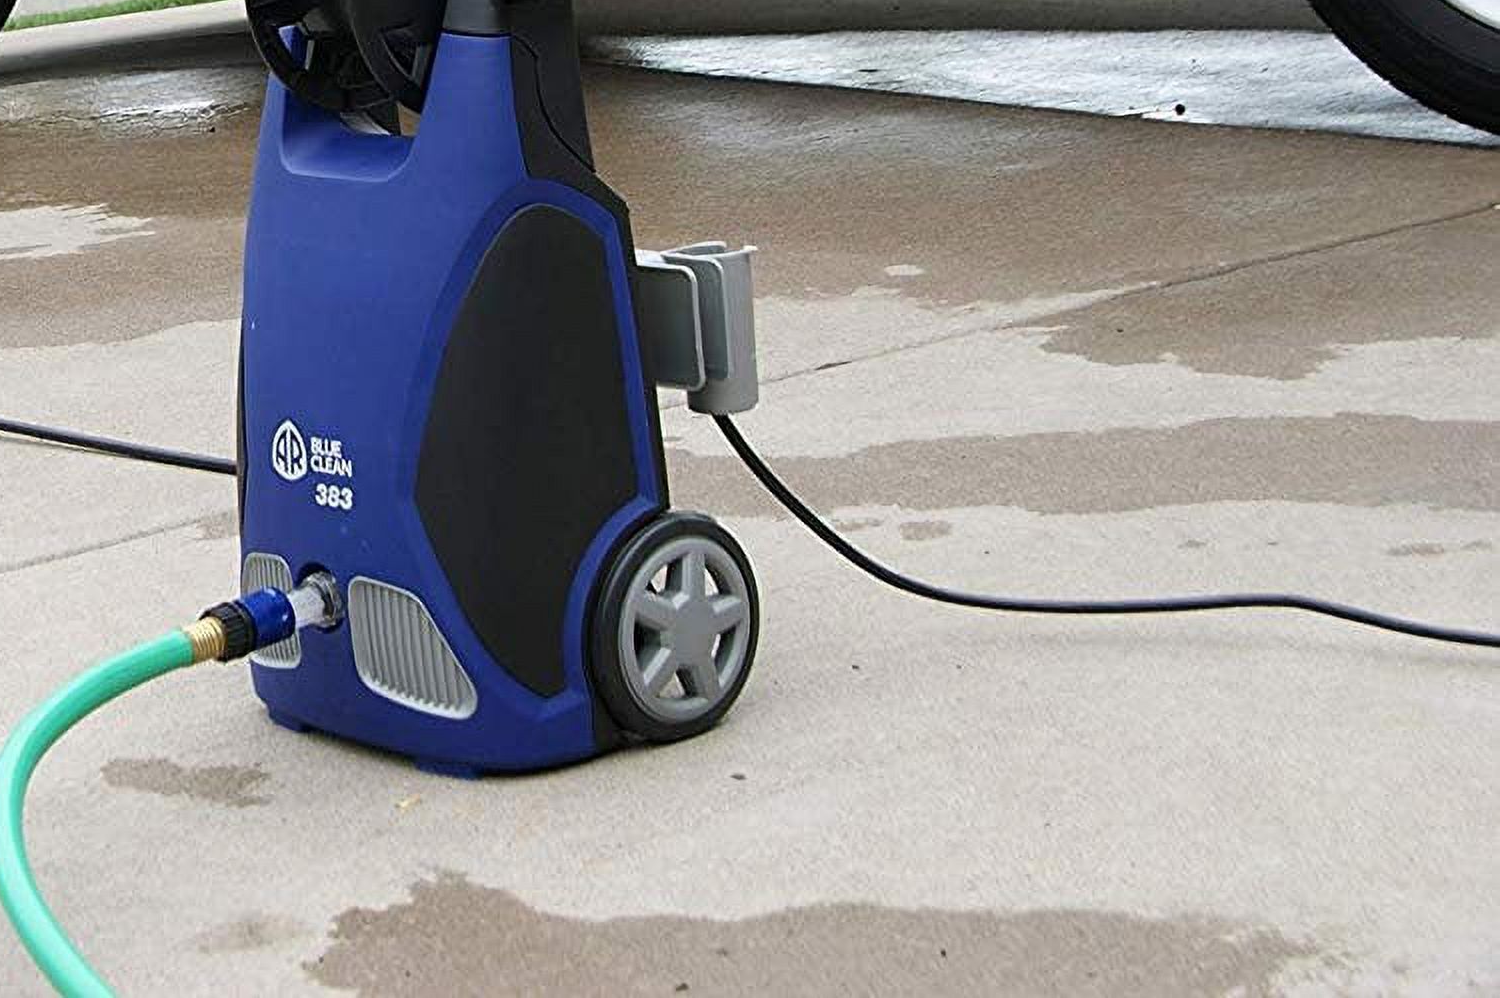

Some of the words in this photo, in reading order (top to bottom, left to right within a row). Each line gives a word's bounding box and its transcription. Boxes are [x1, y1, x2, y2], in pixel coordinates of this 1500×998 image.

[310, 436, 342, 458] BLUE
[310, 455, 352, 477] CLEAN
[315, 483, 353, 510] 383
